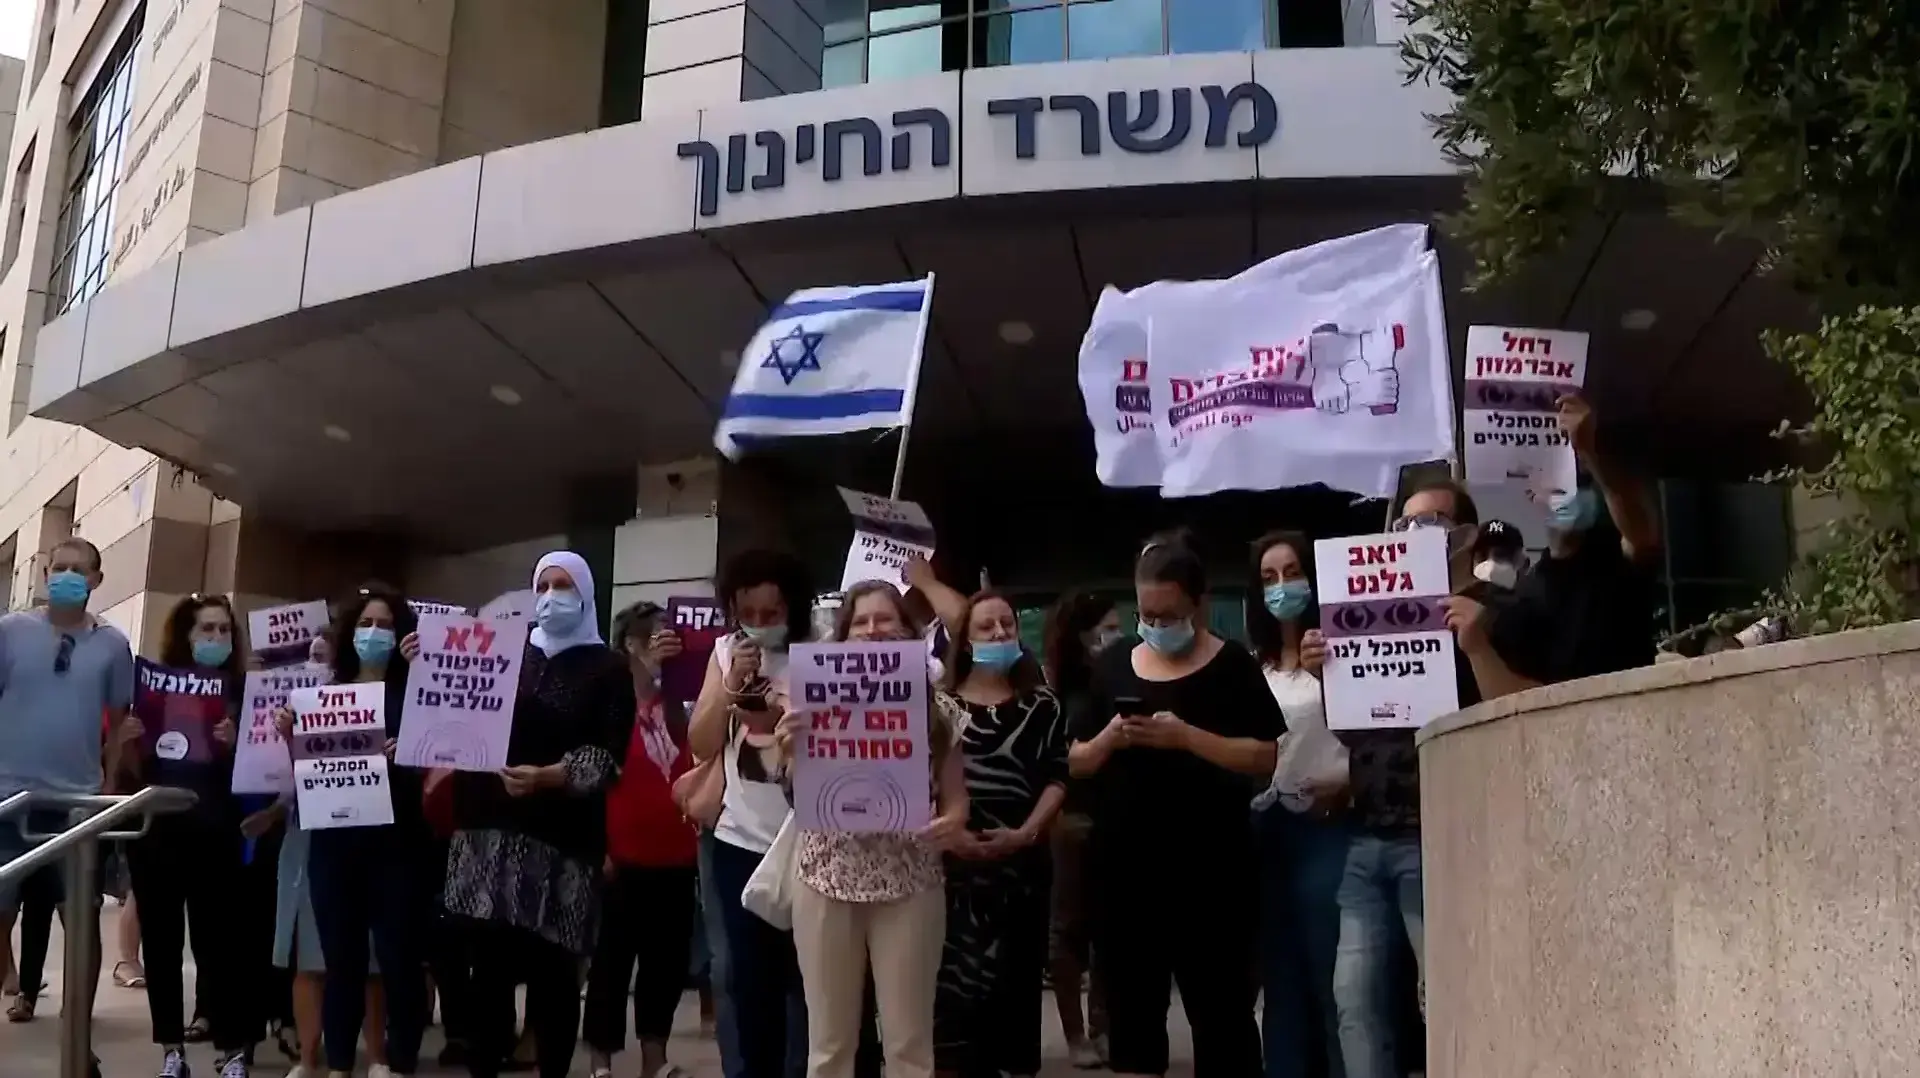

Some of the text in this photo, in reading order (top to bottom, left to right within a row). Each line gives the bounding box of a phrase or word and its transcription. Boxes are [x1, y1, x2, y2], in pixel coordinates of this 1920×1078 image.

[677, 82, 1278, 216] משרד החינוך
[1503, 331, 1552, 355] רחל
[1476, 356, 1575, 378] אברמזון
[1487, 411, 1557, 428] תסתכלי
[1474, 430, 1570, 446] לנו בעיניים
[864, 552, 903, 569] עיניים
[1348, 541, 1408, 566] יואב
[1347, 569, 1414, 594] גלנט
[269, 609, 304, 626] יואב
[268, 627, 310, 644] גלנט
[443, 622, 497, 655] לא
[1333, 637, 1441, 658] תסתכל לנו
[423, 652, 511, 674] לפיטורי
[813, 652, 901, 675] עובדי
[1352, 660, 1426, 678] בעיניים
[141, 665, 222, 696] האלונקה
[432, 673, 494, 692] עובדי
[805, 675, 912, 704] שלבים
[318, 690, 356, 707] רחל
[417, 687, 503, 711] שלבים!
[301, 709, 376, 732] אברמזון
[811, 705, 908, 731] הם לא
[808, 735, 913, 760] סחורה!
[313, 760, 368, 774] תסתכלי
[304, 772, 380, 790] לנו בעיניים
